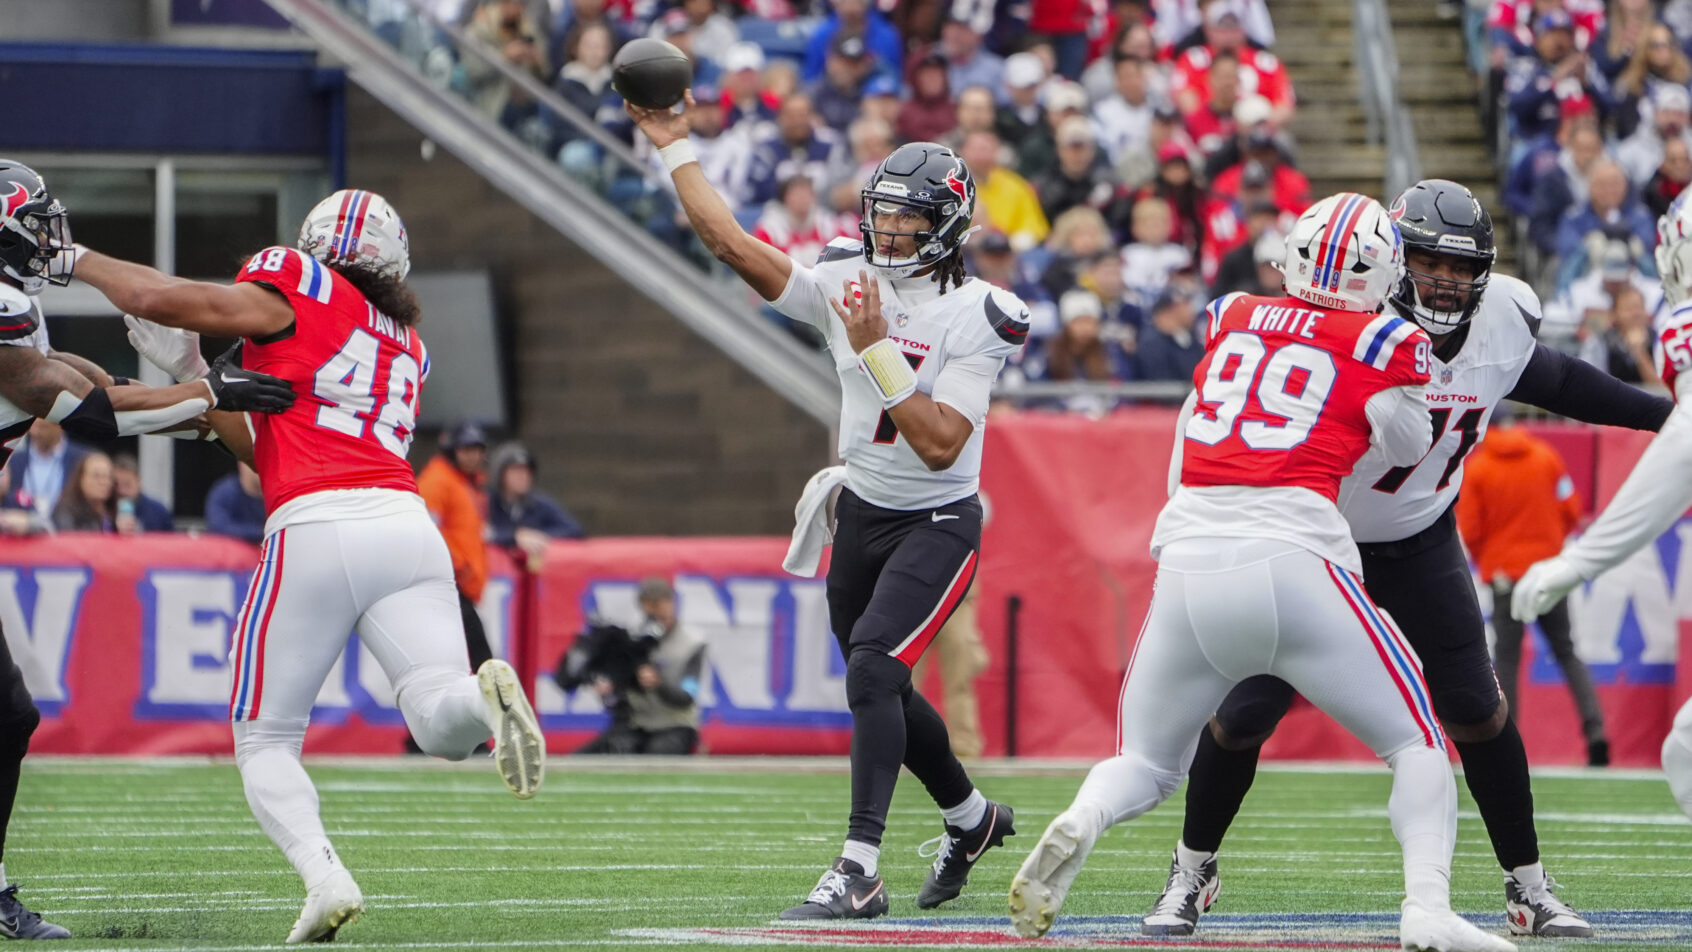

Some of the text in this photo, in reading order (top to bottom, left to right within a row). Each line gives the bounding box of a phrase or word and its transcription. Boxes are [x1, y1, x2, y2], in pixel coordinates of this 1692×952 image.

[246, 249, 288, 274] 48
[1300, 288, 1347, 309] PATRIOTS
[1247, 304, 1325, 339] WHITE
[888, 334, 931, 352] STON
[313, 326, 418, 460] 48
[1184, 330, 1339, 450] 99
